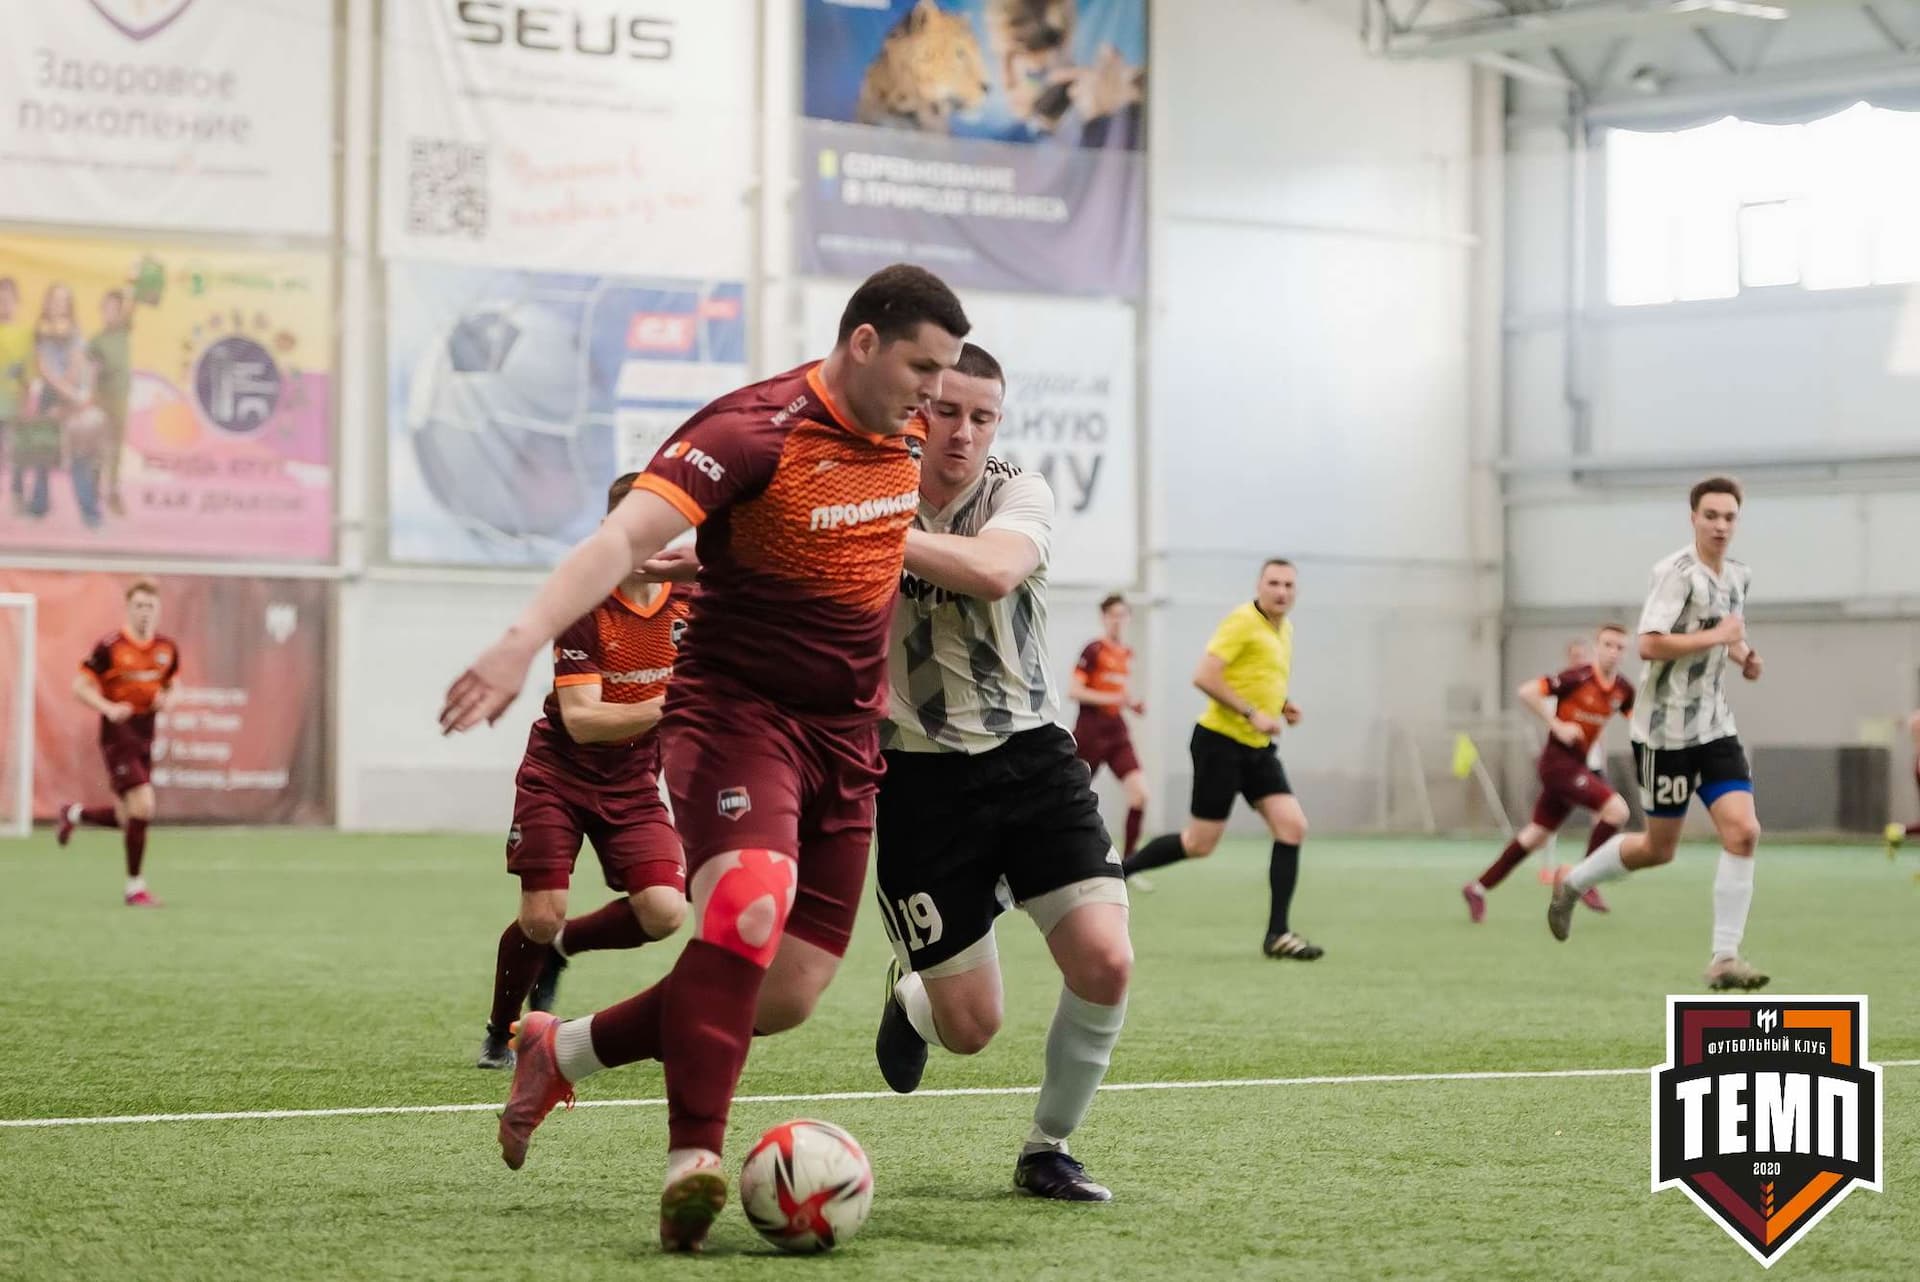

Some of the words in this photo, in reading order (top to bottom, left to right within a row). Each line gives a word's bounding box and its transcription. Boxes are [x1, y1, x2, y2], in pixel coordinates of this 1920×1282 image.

[458, 0, 674, 60] SEUS
[684, 447, 726, 482] ПСБ
[1656, 775, 1688, 805] 20
[898, 892, 943, 951] 19
